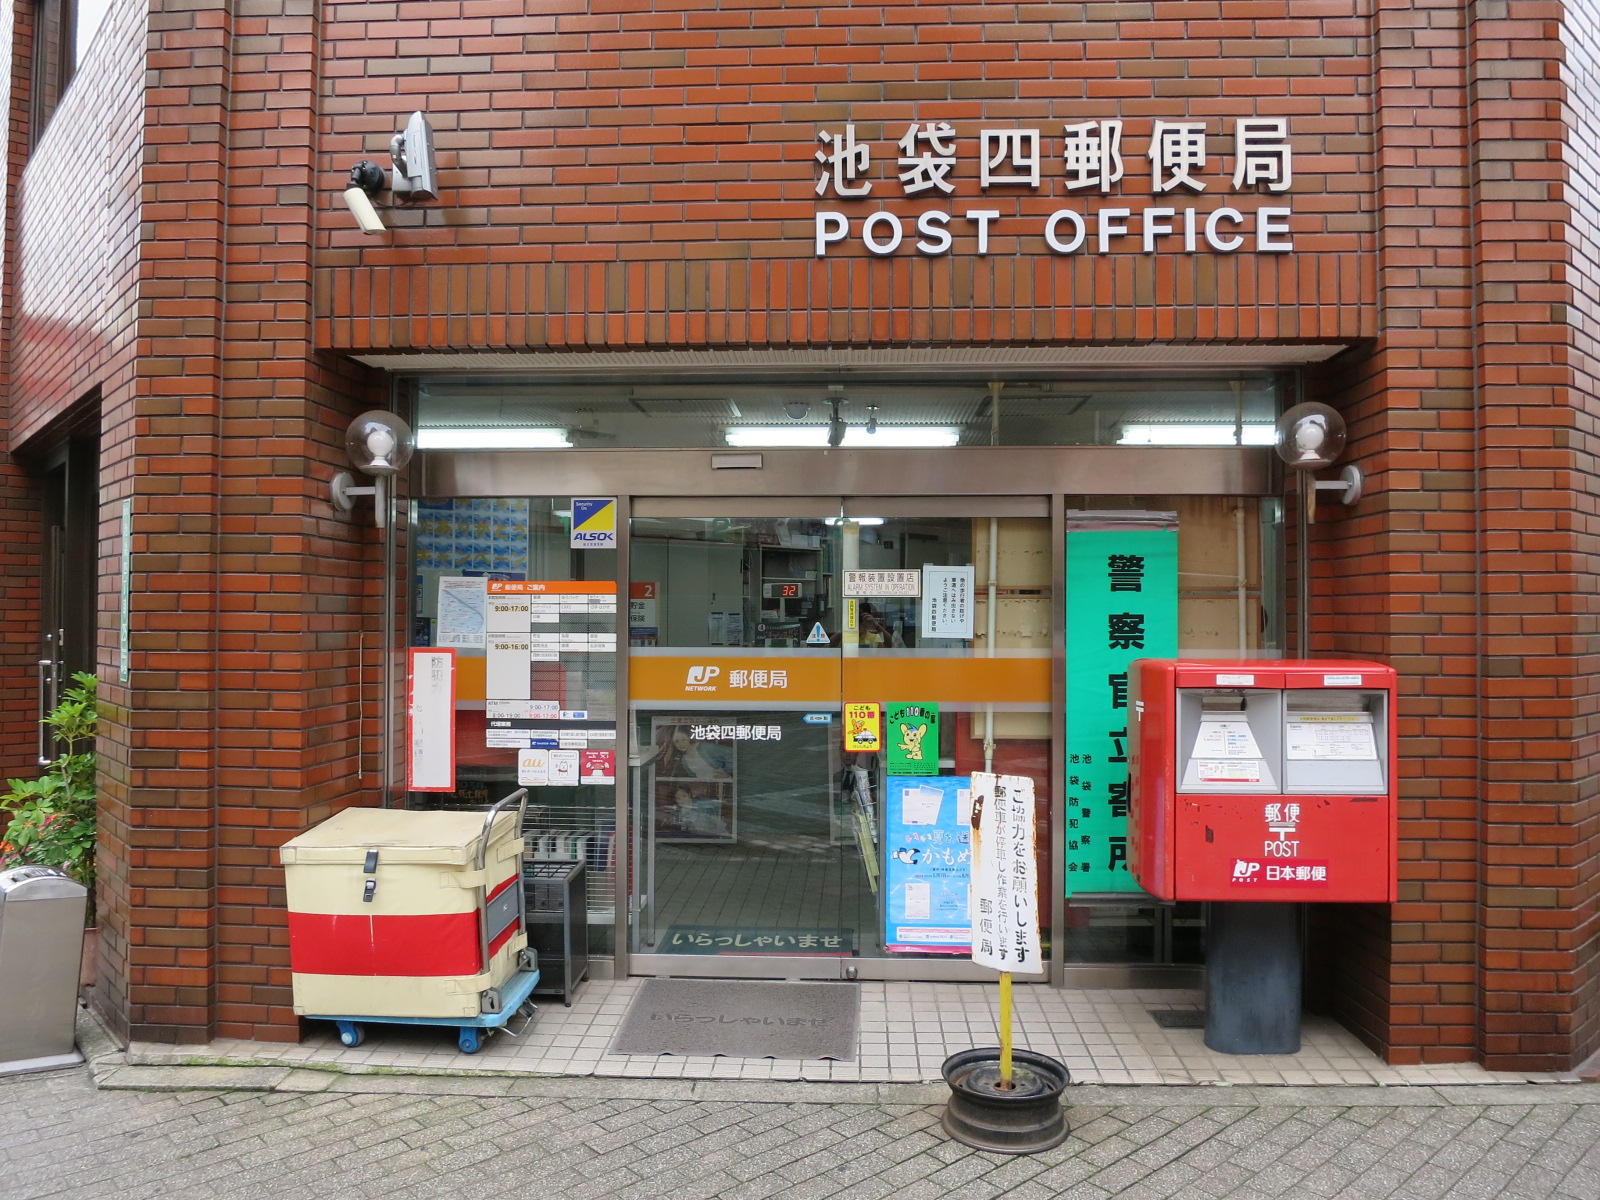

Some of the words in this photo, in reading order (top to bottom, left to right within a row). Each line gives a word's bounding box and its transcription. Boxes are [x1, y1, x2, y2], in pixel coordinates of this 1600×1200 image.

[815, 118, 1293, 197] 池袋四郵便局
[815, 208, 1000, 256] POST
[1044, 207, 1293, 255] OFFICE
[573, 532, 614, 541] ALSOK
[848, 573, 914, 583] 警報装置設置店
[644, 585, 653, 597] 2
[782, 585, 796, 596] 32
[847, 583, 863, 591] ALARM
[890, 583, 915, 591] OPERATION
[630, 601, 645, 610] 貯金
[630, 614, 646, 623] 保険
[729, 670, 788, 689] 郵便局
[849, 711, 876, 719] 110番
[690, 724, 782, 741] 池袋四郵便局
[523, 758, 545, 768] au
[1068, 753, 1080, 872] 池袋防犯協会
[1080, 753, 1093, 873] 池袋警察署
[1264, 802, 1301, 823] 郵便
[1264, 840, 1300, 858] POST
[994, 785, 1010, 961] 郵便車が停車し作業を行います
[1011, 788, 1030, 963] ご協力をお願いします
[1266, 865, 1327, 881] 日本郵便
[979, 898, 993, 957] 郵便局
[672, 932, 843, 949] いらっしゃいませ
[650, 1012, 830, 1028] いらっしゃいませ
